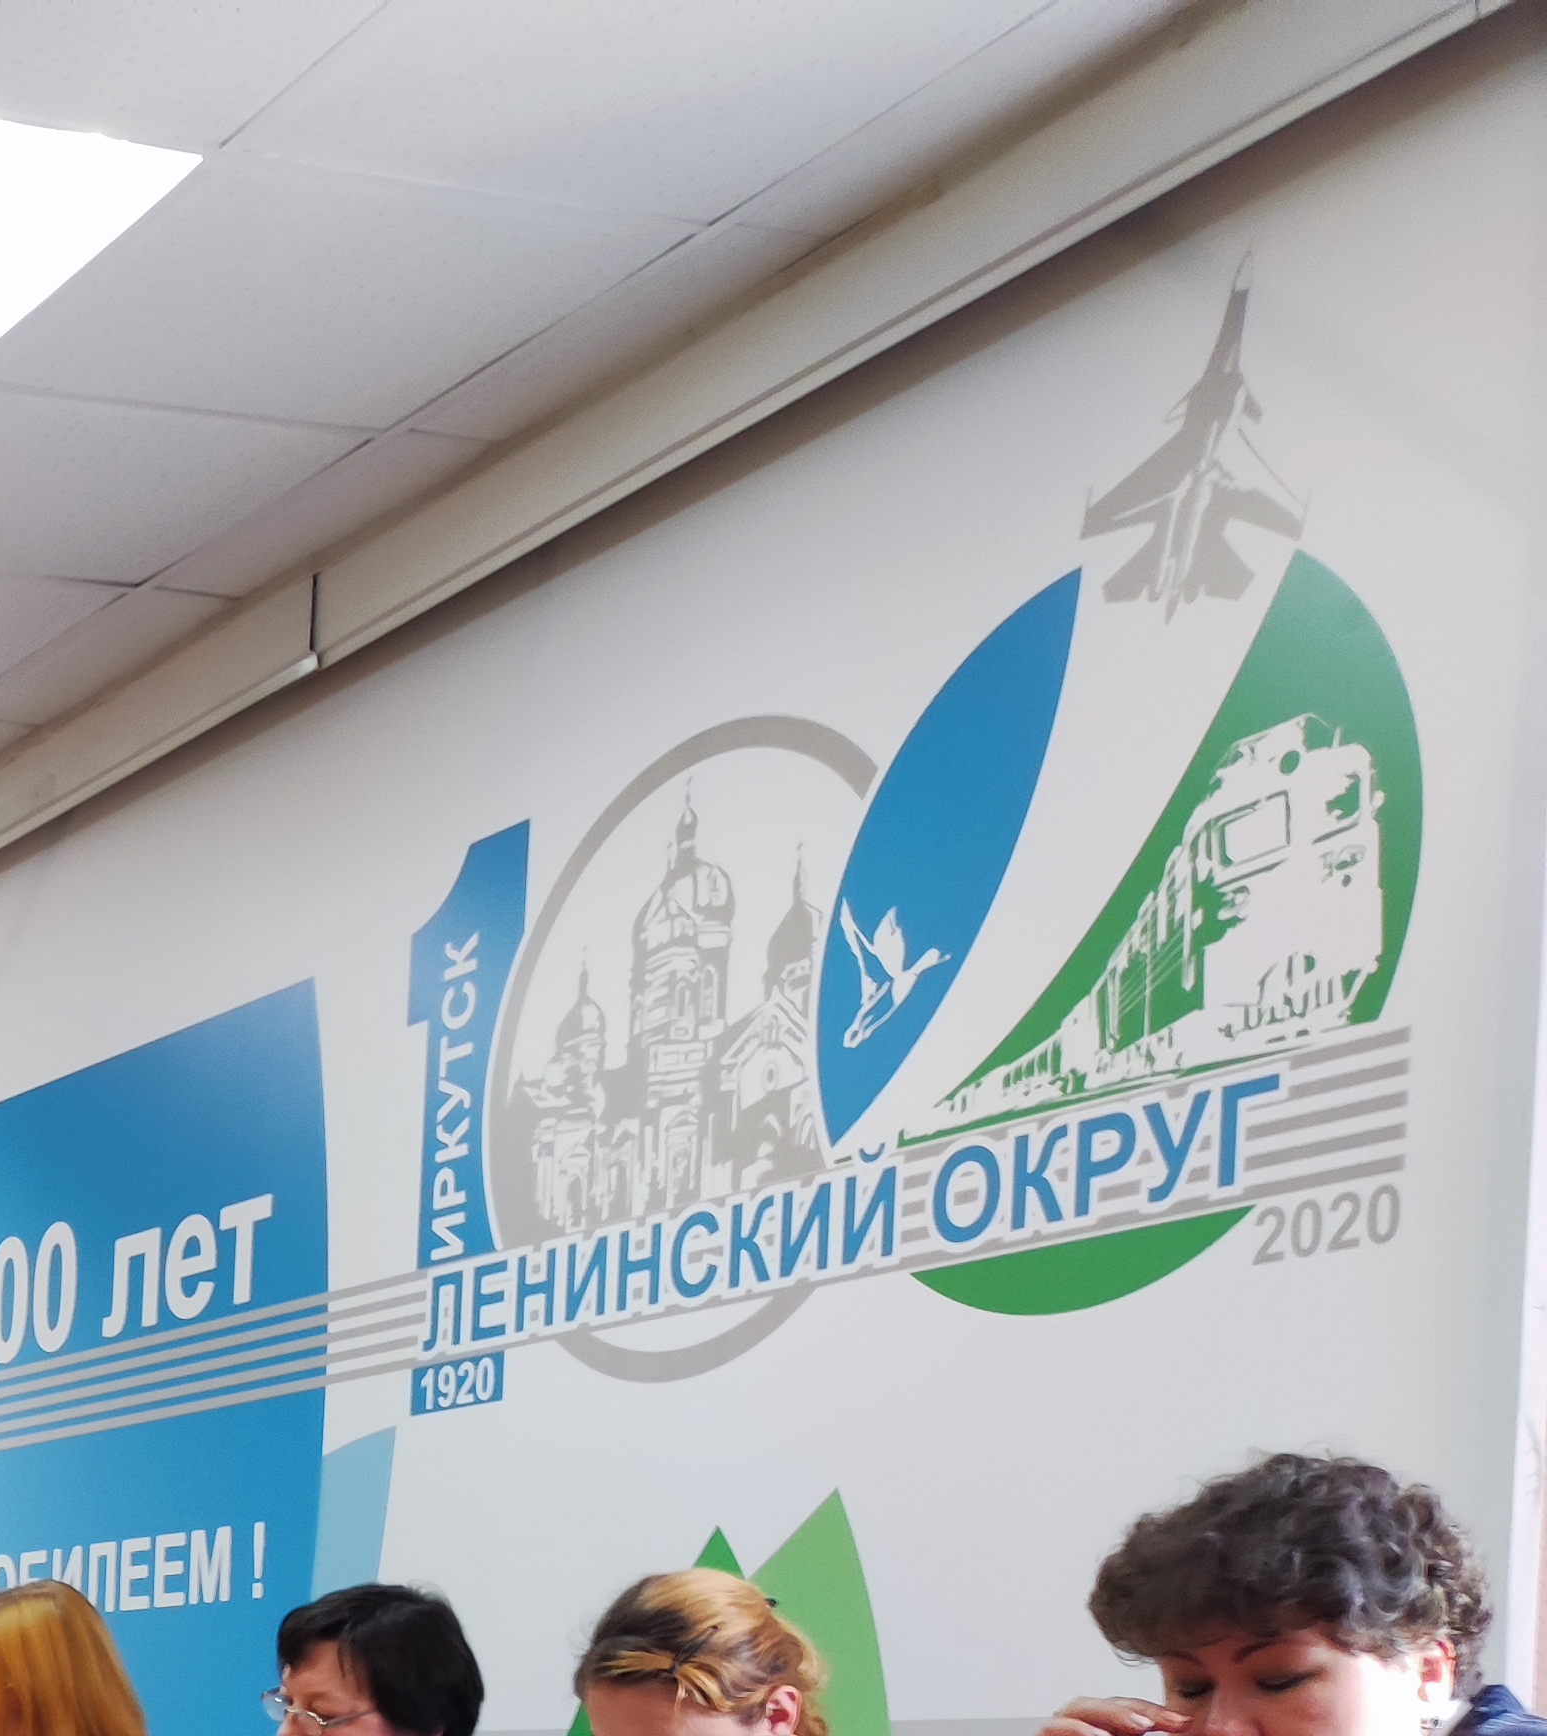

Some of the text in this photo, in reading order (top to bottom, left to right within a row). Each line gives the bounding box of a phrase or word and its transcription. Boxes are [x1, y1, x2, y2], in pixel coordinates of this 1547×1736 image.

[426, 930, 480, 1259] ИРКУТСК
[101, 1194, 274, 1339] лет
[422, 1073, 1281, 1354] ЛЕНИНСКИЙ ОКРУГ
[1251, 1184, 1403, 1266] 2020
[419, 1361, 495, 1410] 1920
